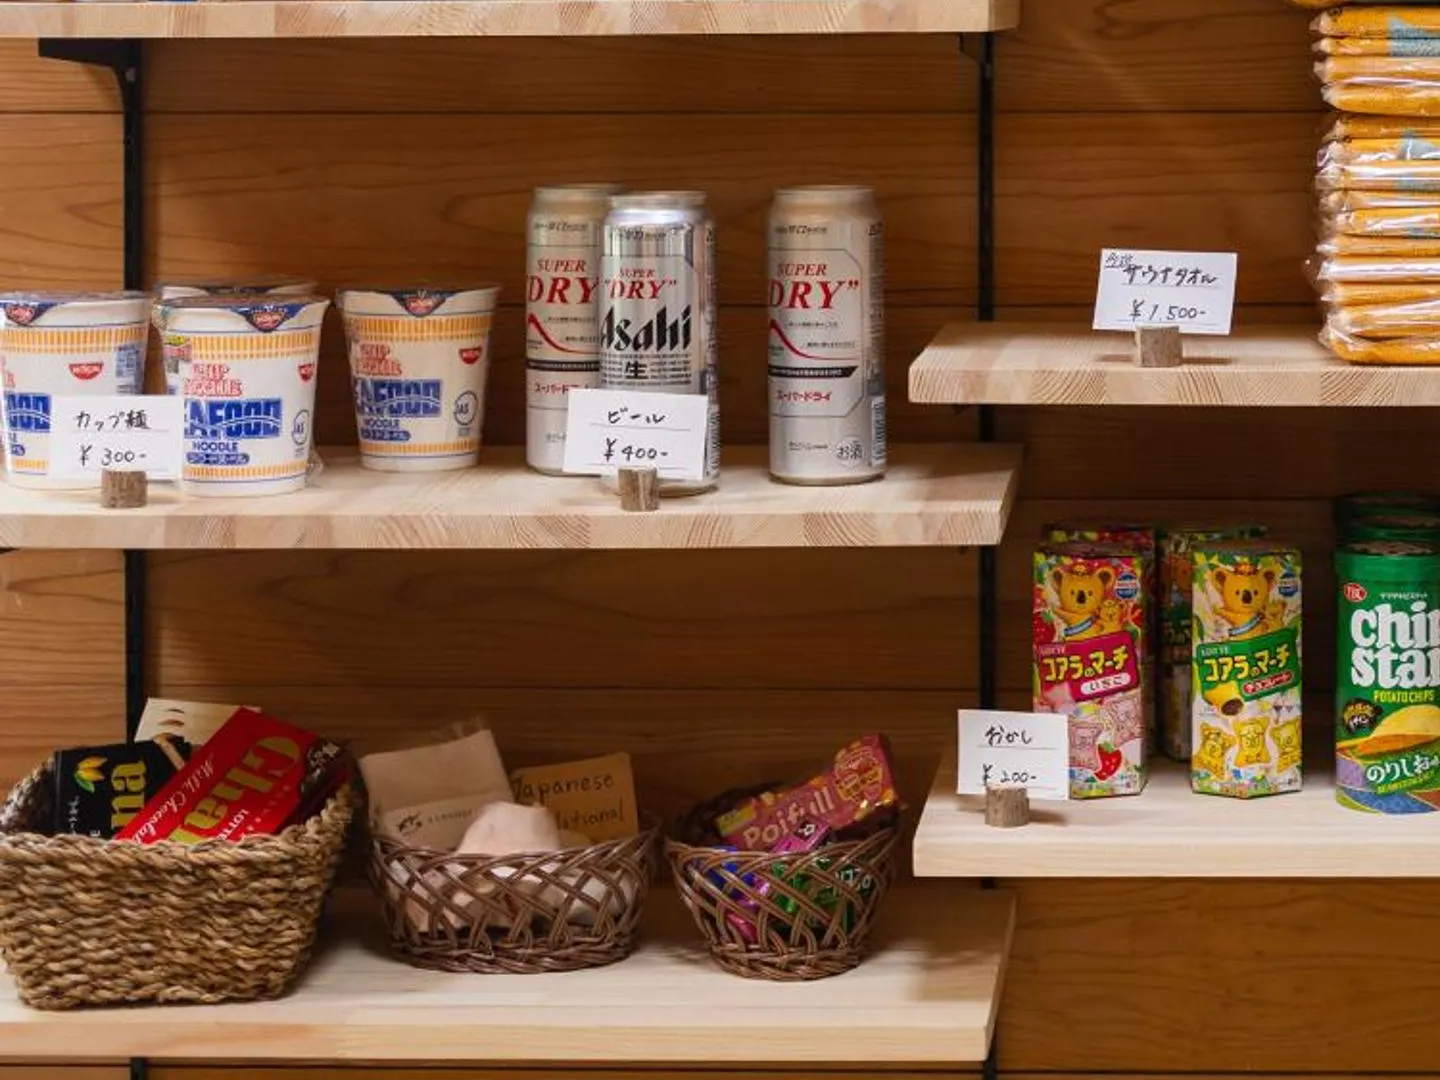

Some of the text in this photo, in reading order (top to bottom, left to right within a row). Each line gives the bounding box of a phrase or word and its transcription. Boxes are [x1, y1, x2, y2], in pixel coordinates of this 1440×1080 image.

[537, 260, 586, 272] SUPER
[620, 269, 655, 277] SUPER
[778, 264, 827, 276] SUPER
[601, 305, 692, 351] Asahi
[625, 360, 648, 379] 生
[777, 390, 832, 402] スーパードライ
[76, 410, 150, 431] カップ麺
[608, 406, 665, 424] ビール
[192, 443, 239, 452] NOODLE
[1043, 646, 1128, 681] コアラのマーチ
[1204, 644, 1290, 682] コアラのマーチ
[985, 725, 1032, 746] おかし
[512, 773, 615, 804] Japanese
